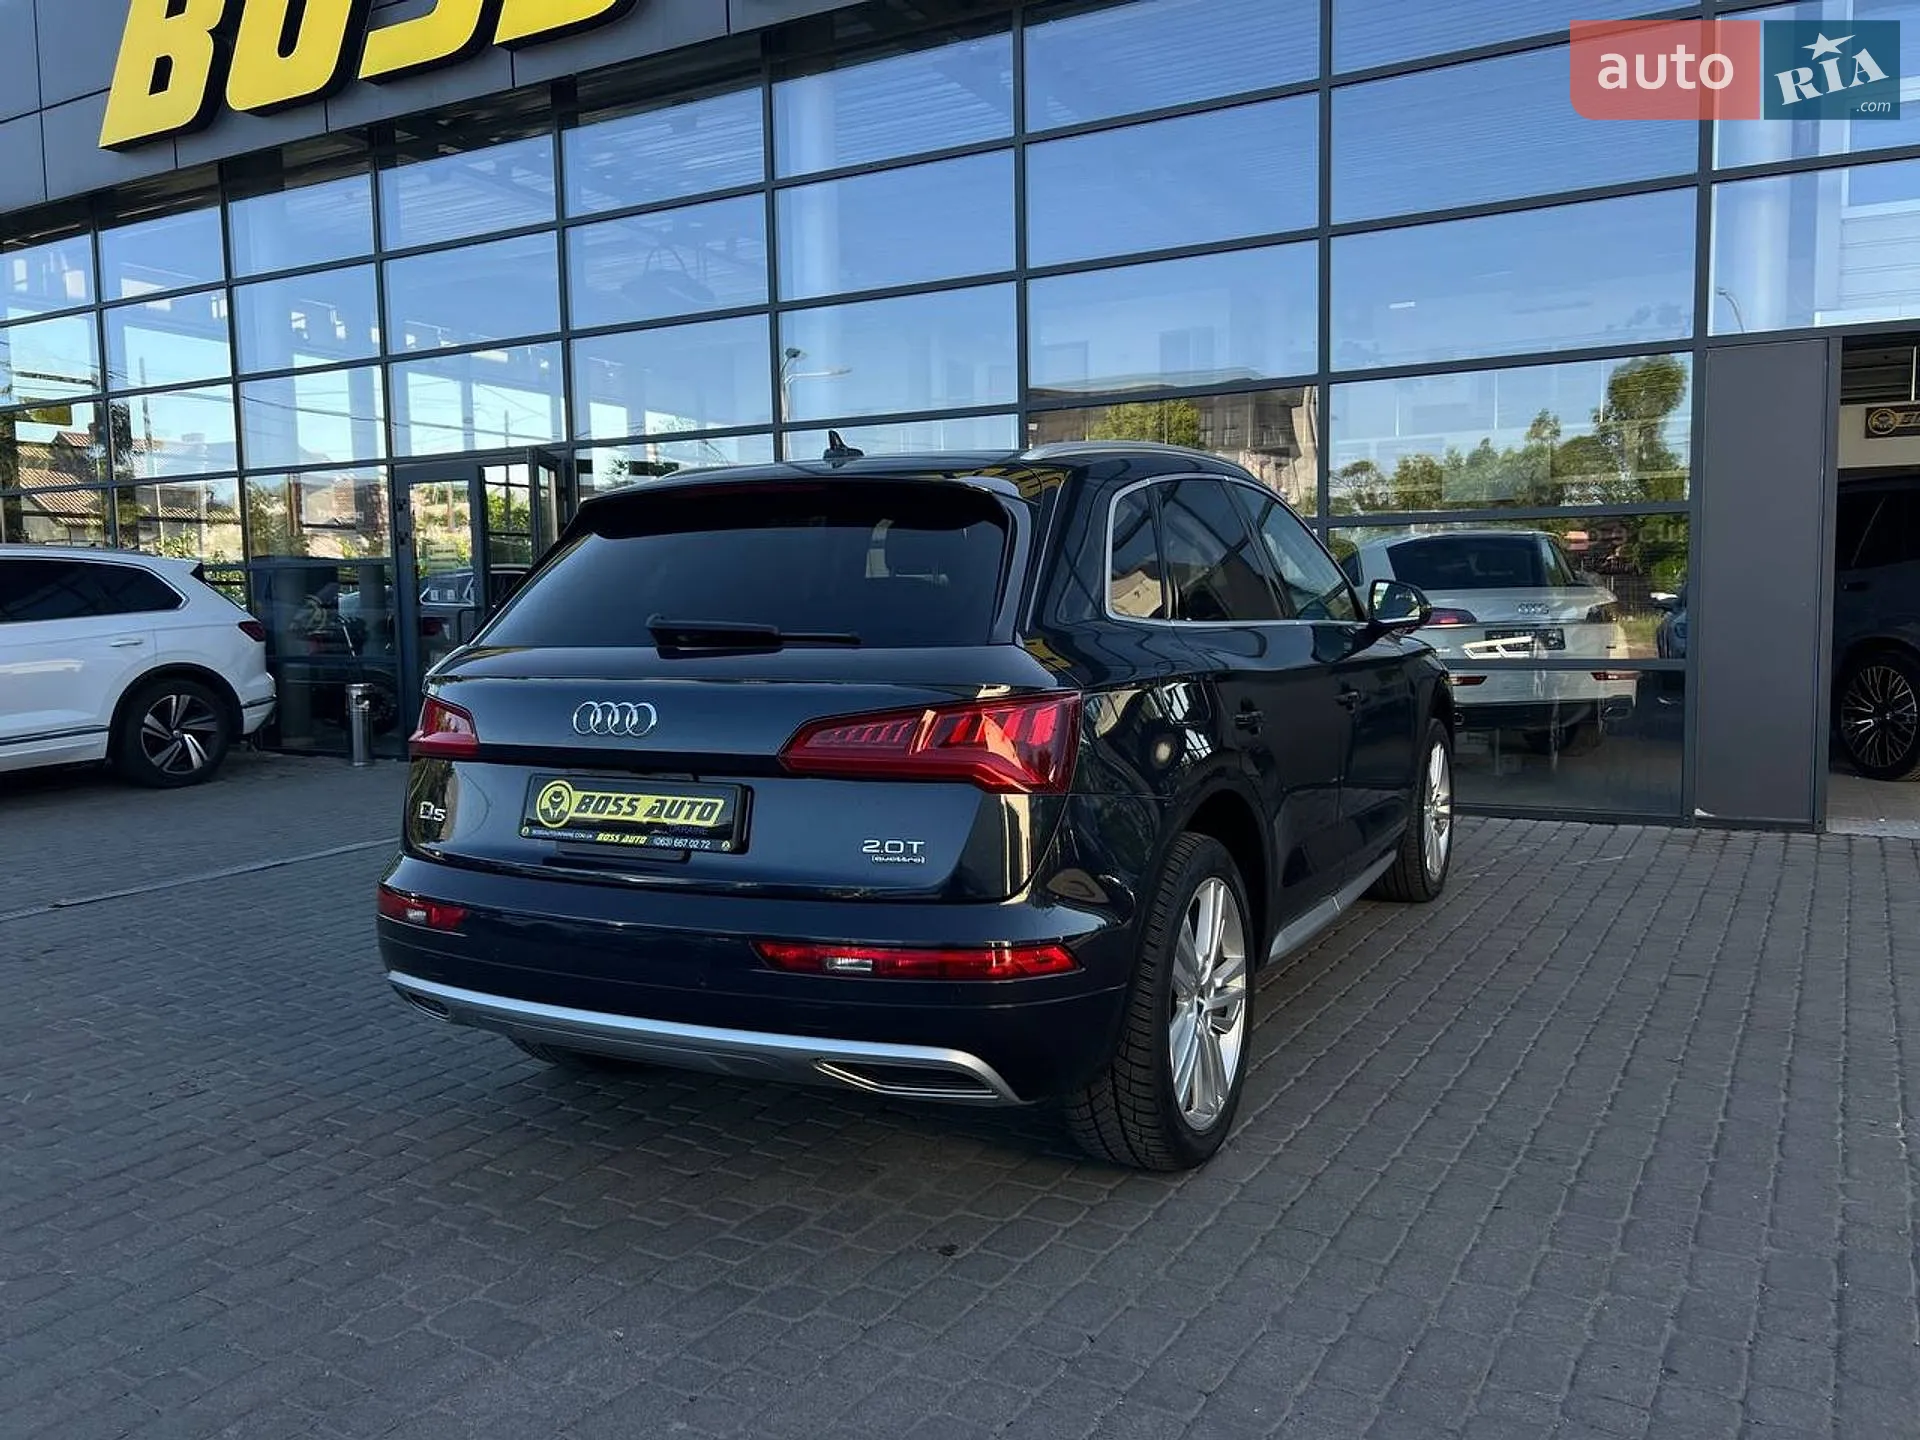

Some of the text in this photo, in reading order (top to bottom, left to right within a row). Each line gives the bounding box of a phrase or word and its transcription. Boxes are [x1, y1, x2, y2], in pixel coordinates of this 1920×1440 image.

[420, 801, 446, 821] Q5
[576, 794, 718, 820] BOSS AUTO
[596, 832, 620, 842] BOSS
[621, 835, 647, 844] AUTO
[700, 840, 711, 849] 72
[863, 840, 925, 854] 2.0T
